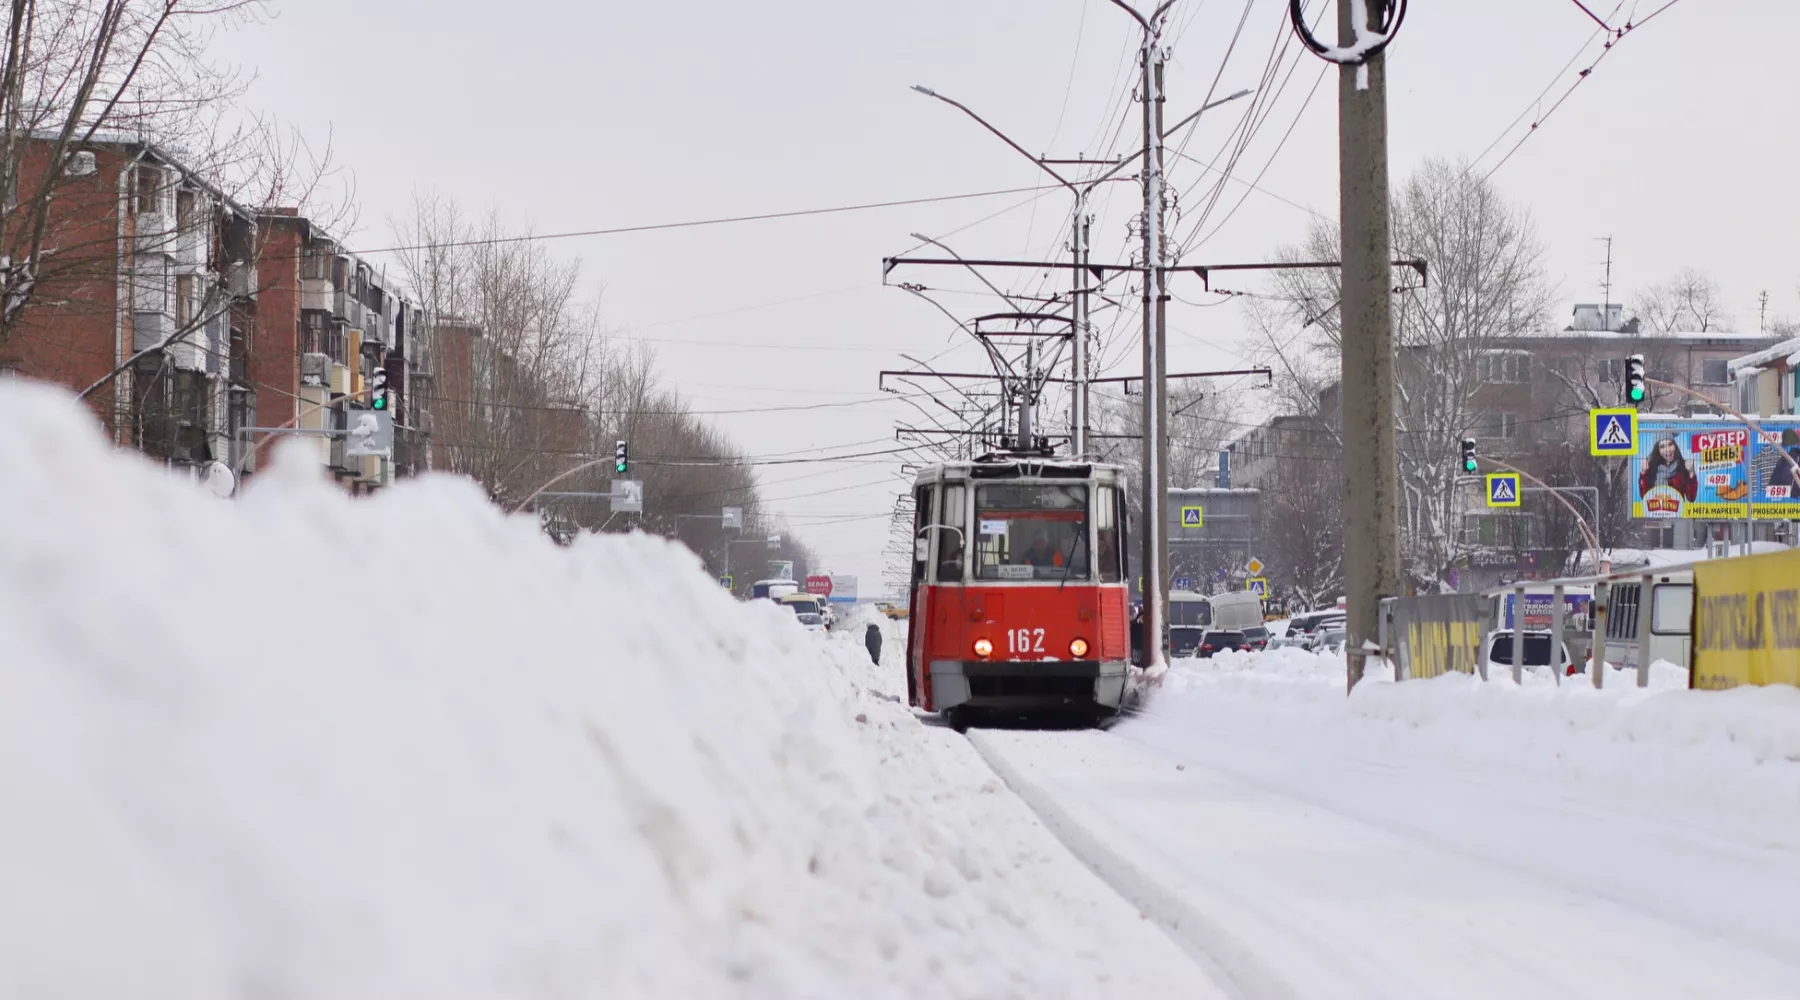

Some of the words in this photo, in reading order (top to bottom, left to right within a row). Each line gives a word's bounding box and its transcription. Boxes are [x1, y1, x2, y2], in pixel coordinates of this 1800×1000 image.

[1698, 430, 1745, 450] СУПЕР
[1709, 475, 1726, 484] 499
[1770, 487, 1786, 496] 699
[1008, 628, 1045, 653] 162
